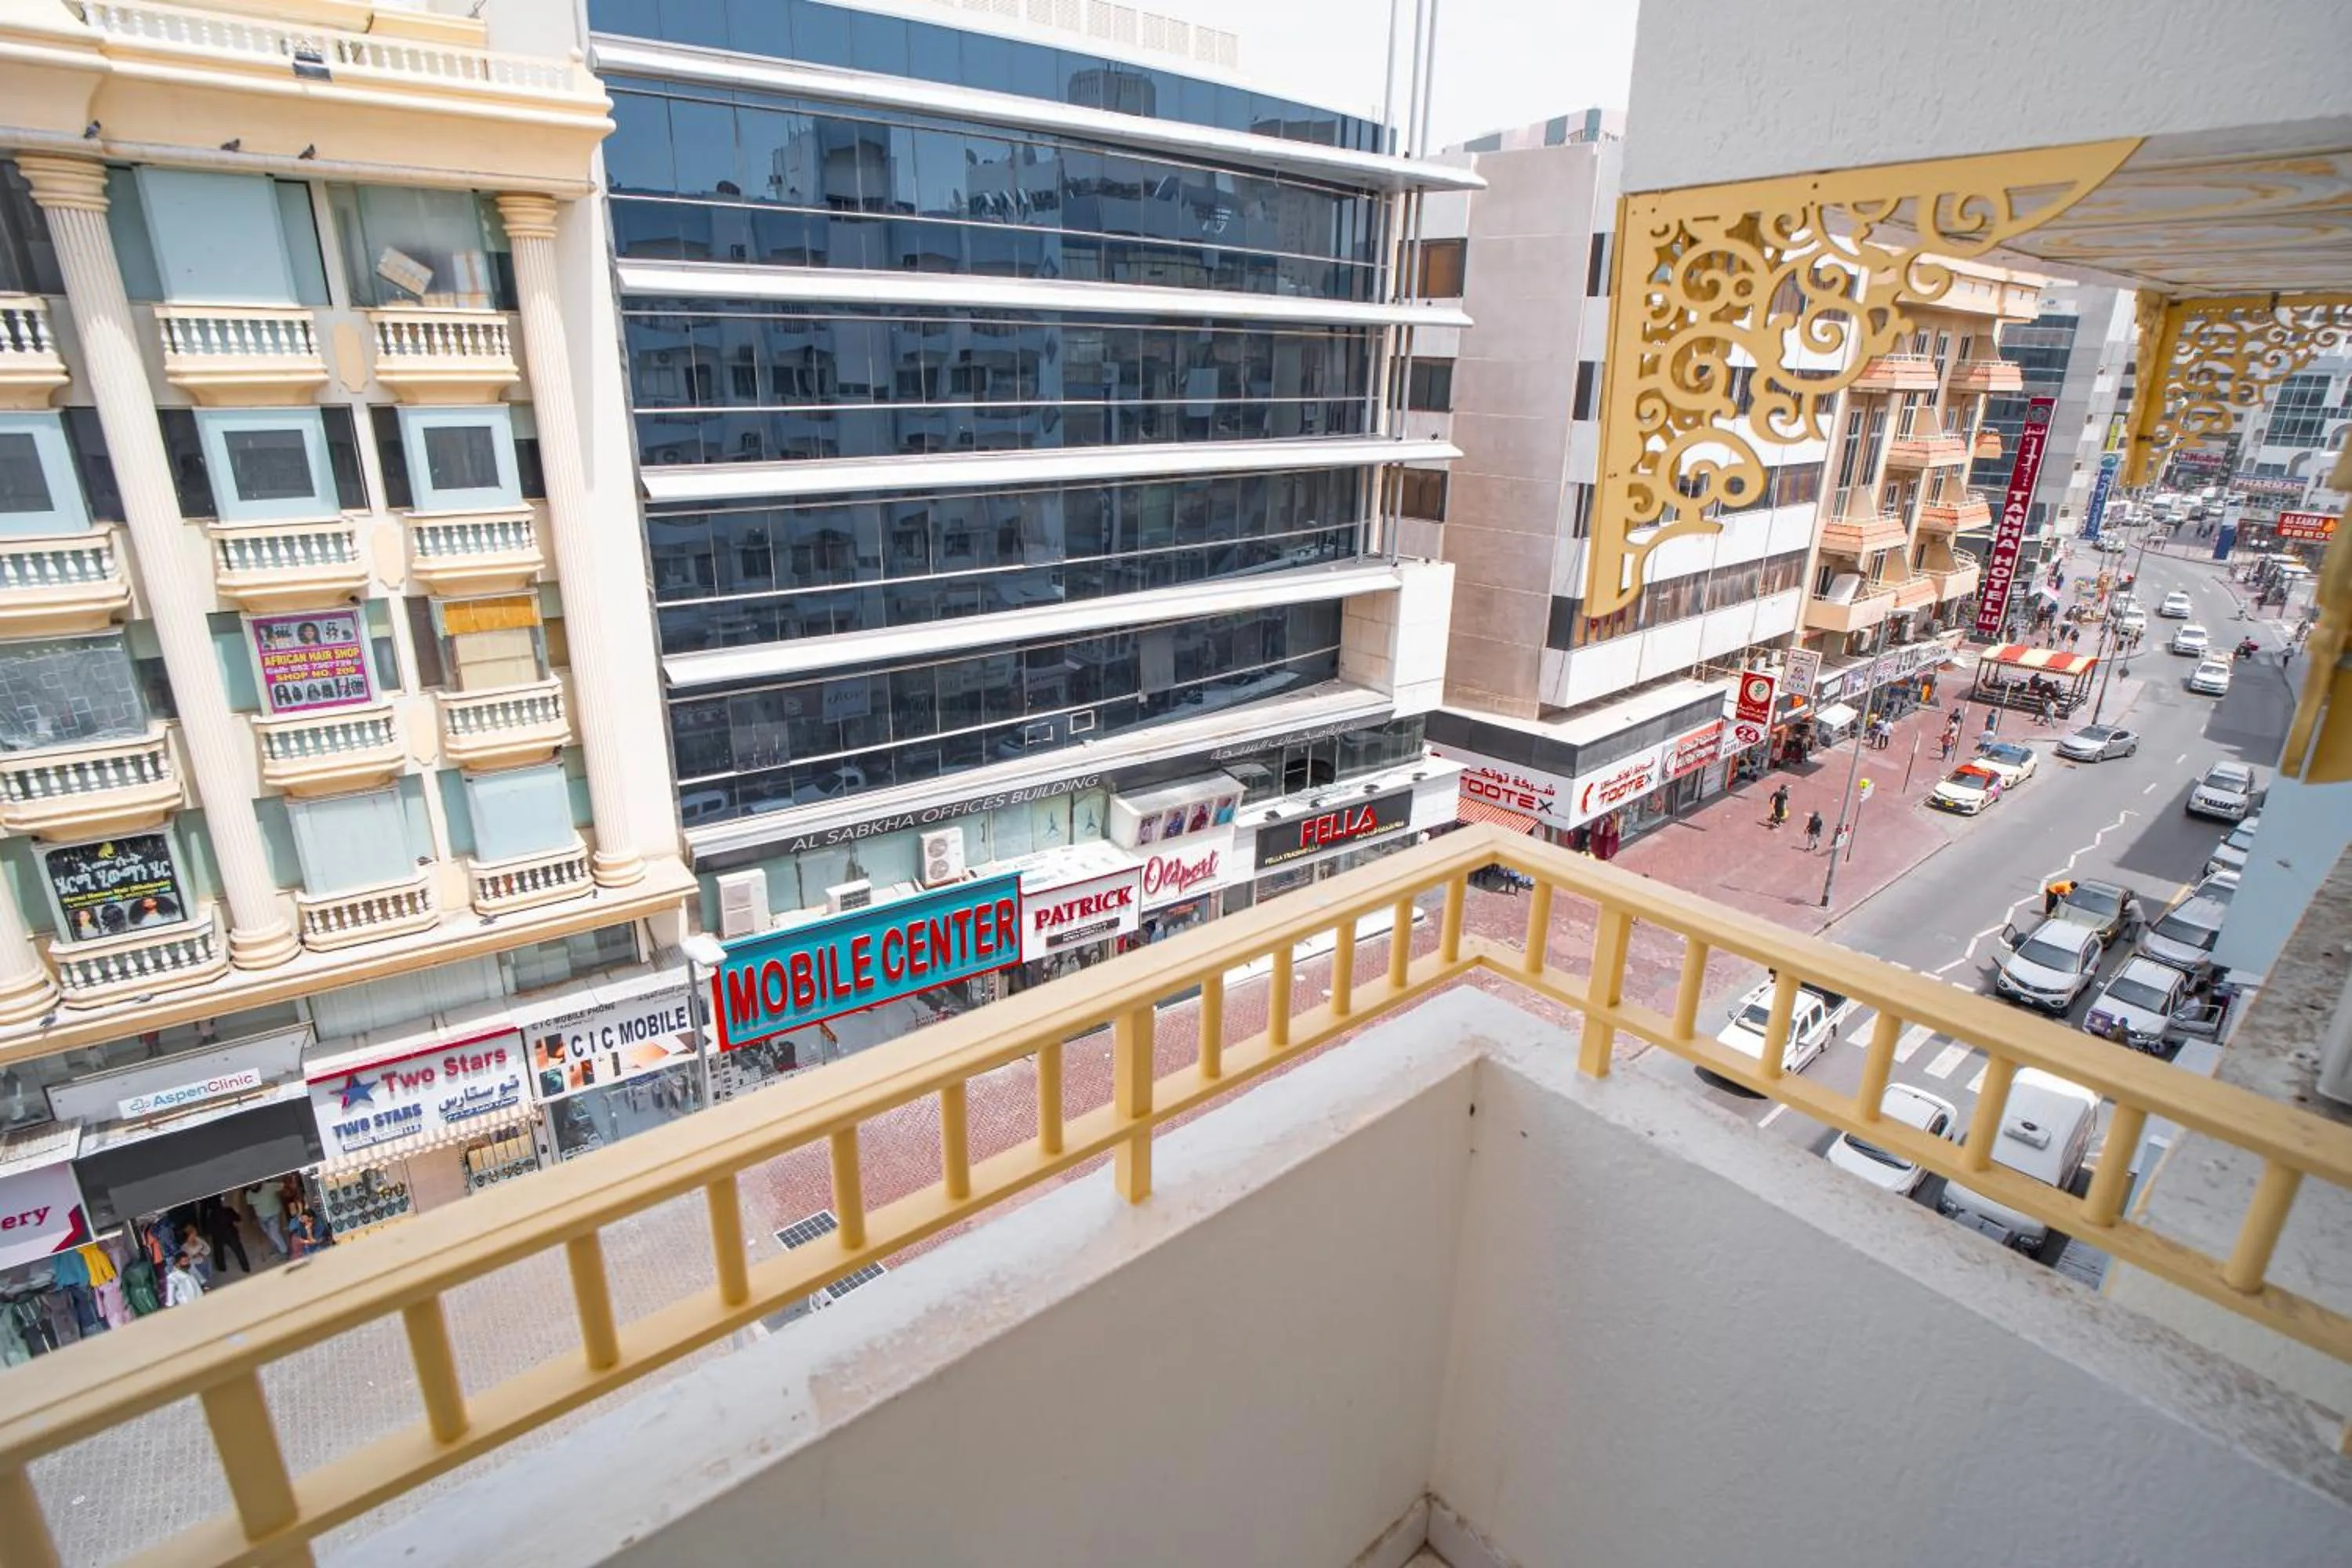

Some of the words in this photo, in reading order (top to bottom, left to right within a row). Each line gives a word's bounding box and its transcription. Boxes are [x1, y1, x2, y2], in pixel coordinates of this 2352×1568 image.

[1998, 490, 2028, 549] TANHA
[1985, 556, 2013, 612] HOTEL
[264, 652, 307, 666] AFRICAN
[309, 650, 332, 662] HAIR
[334, 647, 359, 659] SHOP
[276, 672, 307, 681] SHOP
[1738, 728, 1758, 743] 24
[1598, 771, 1654, 804] TOOTEX
[789, 835, 819, 853] AL
[826, 814, 916, 845] SABKHA
[920, 792, 1006, 823] OFFICES
[1011, 775, 1099, 804] BUILDING
[1300, 804, 1378, 849] FELLA
[1035, 885, 1133, 931] PATRICK
[727, 934, 874, 1025] MOBILE
[882, 898, 1017, 981] CENTER
[619, 1006, 688, 1045] MOBILE
[381, 1066, 434, 1092] Two
[444, 1047, 506, 1076] Stars
[332, 1116, 370, 1138] TWO
[374, 1103, 423, 1127] STARS
[1, 1205, 51, 1230] ery
